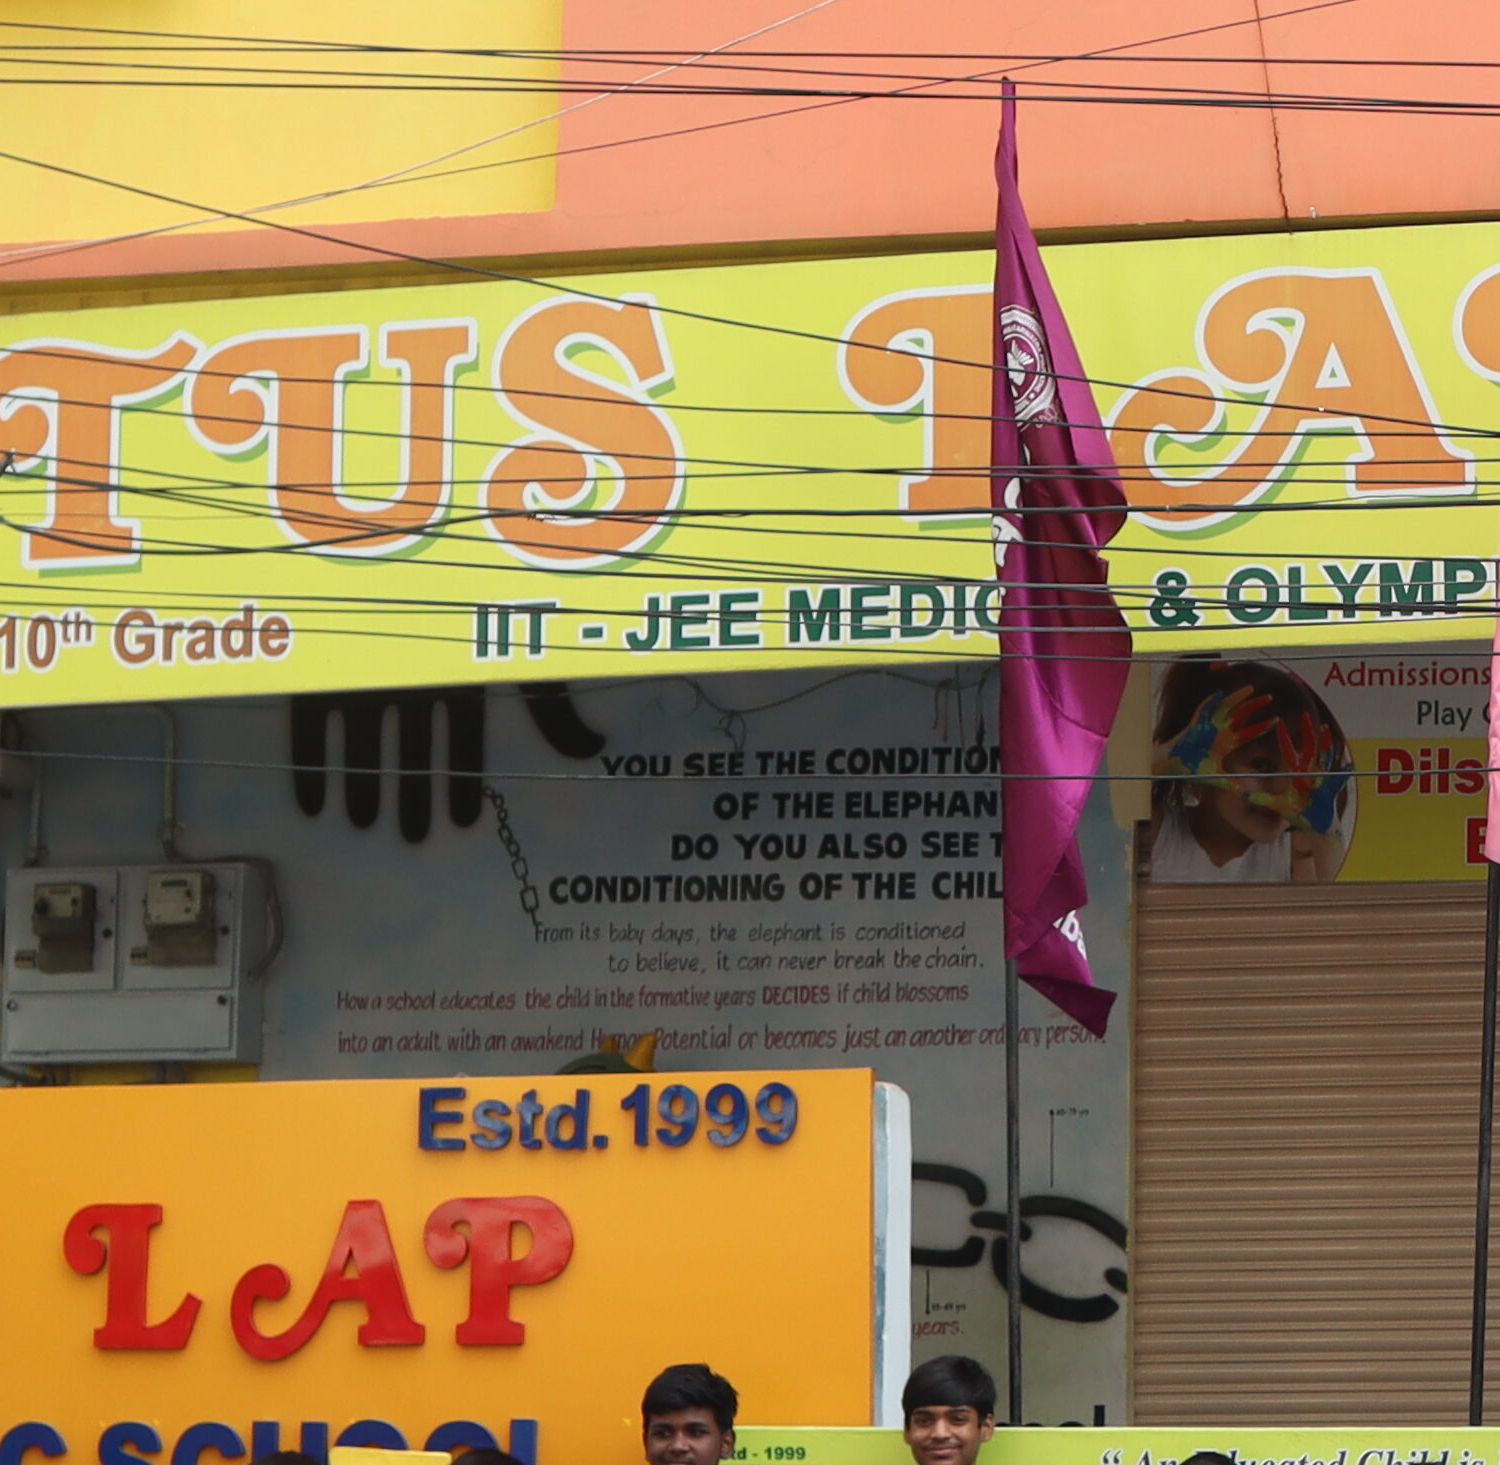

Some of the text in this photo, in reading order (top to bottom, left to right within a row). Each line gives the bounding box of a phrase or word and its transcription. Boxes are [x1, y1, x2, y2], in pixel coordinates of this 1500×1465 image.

[475, 558, 1492, 657] IIT JEE MEDIC & OLYMP
[114, 608, 290, 662] Grade
[1324, 660, 1491, 688] Admissions
[602, 750, 815, 777] YOU SEE THE
[713, 790, 999, 820] OF THE ELEPHAN
[671, 831, 980, 861] DO YOU ALSO SEE
[549, 869, 1003, 905] CONDITIONING OF THE CHIL
[534, 920, 966, 947] From baby the elephant conditioned
[737, 947, 885, 970] can never break
[762, 983, 969, 1005] DECIDES blossoms
[763, 1023, 837, 1051] becomes
[63, 1195, 575, 1364] LAP
